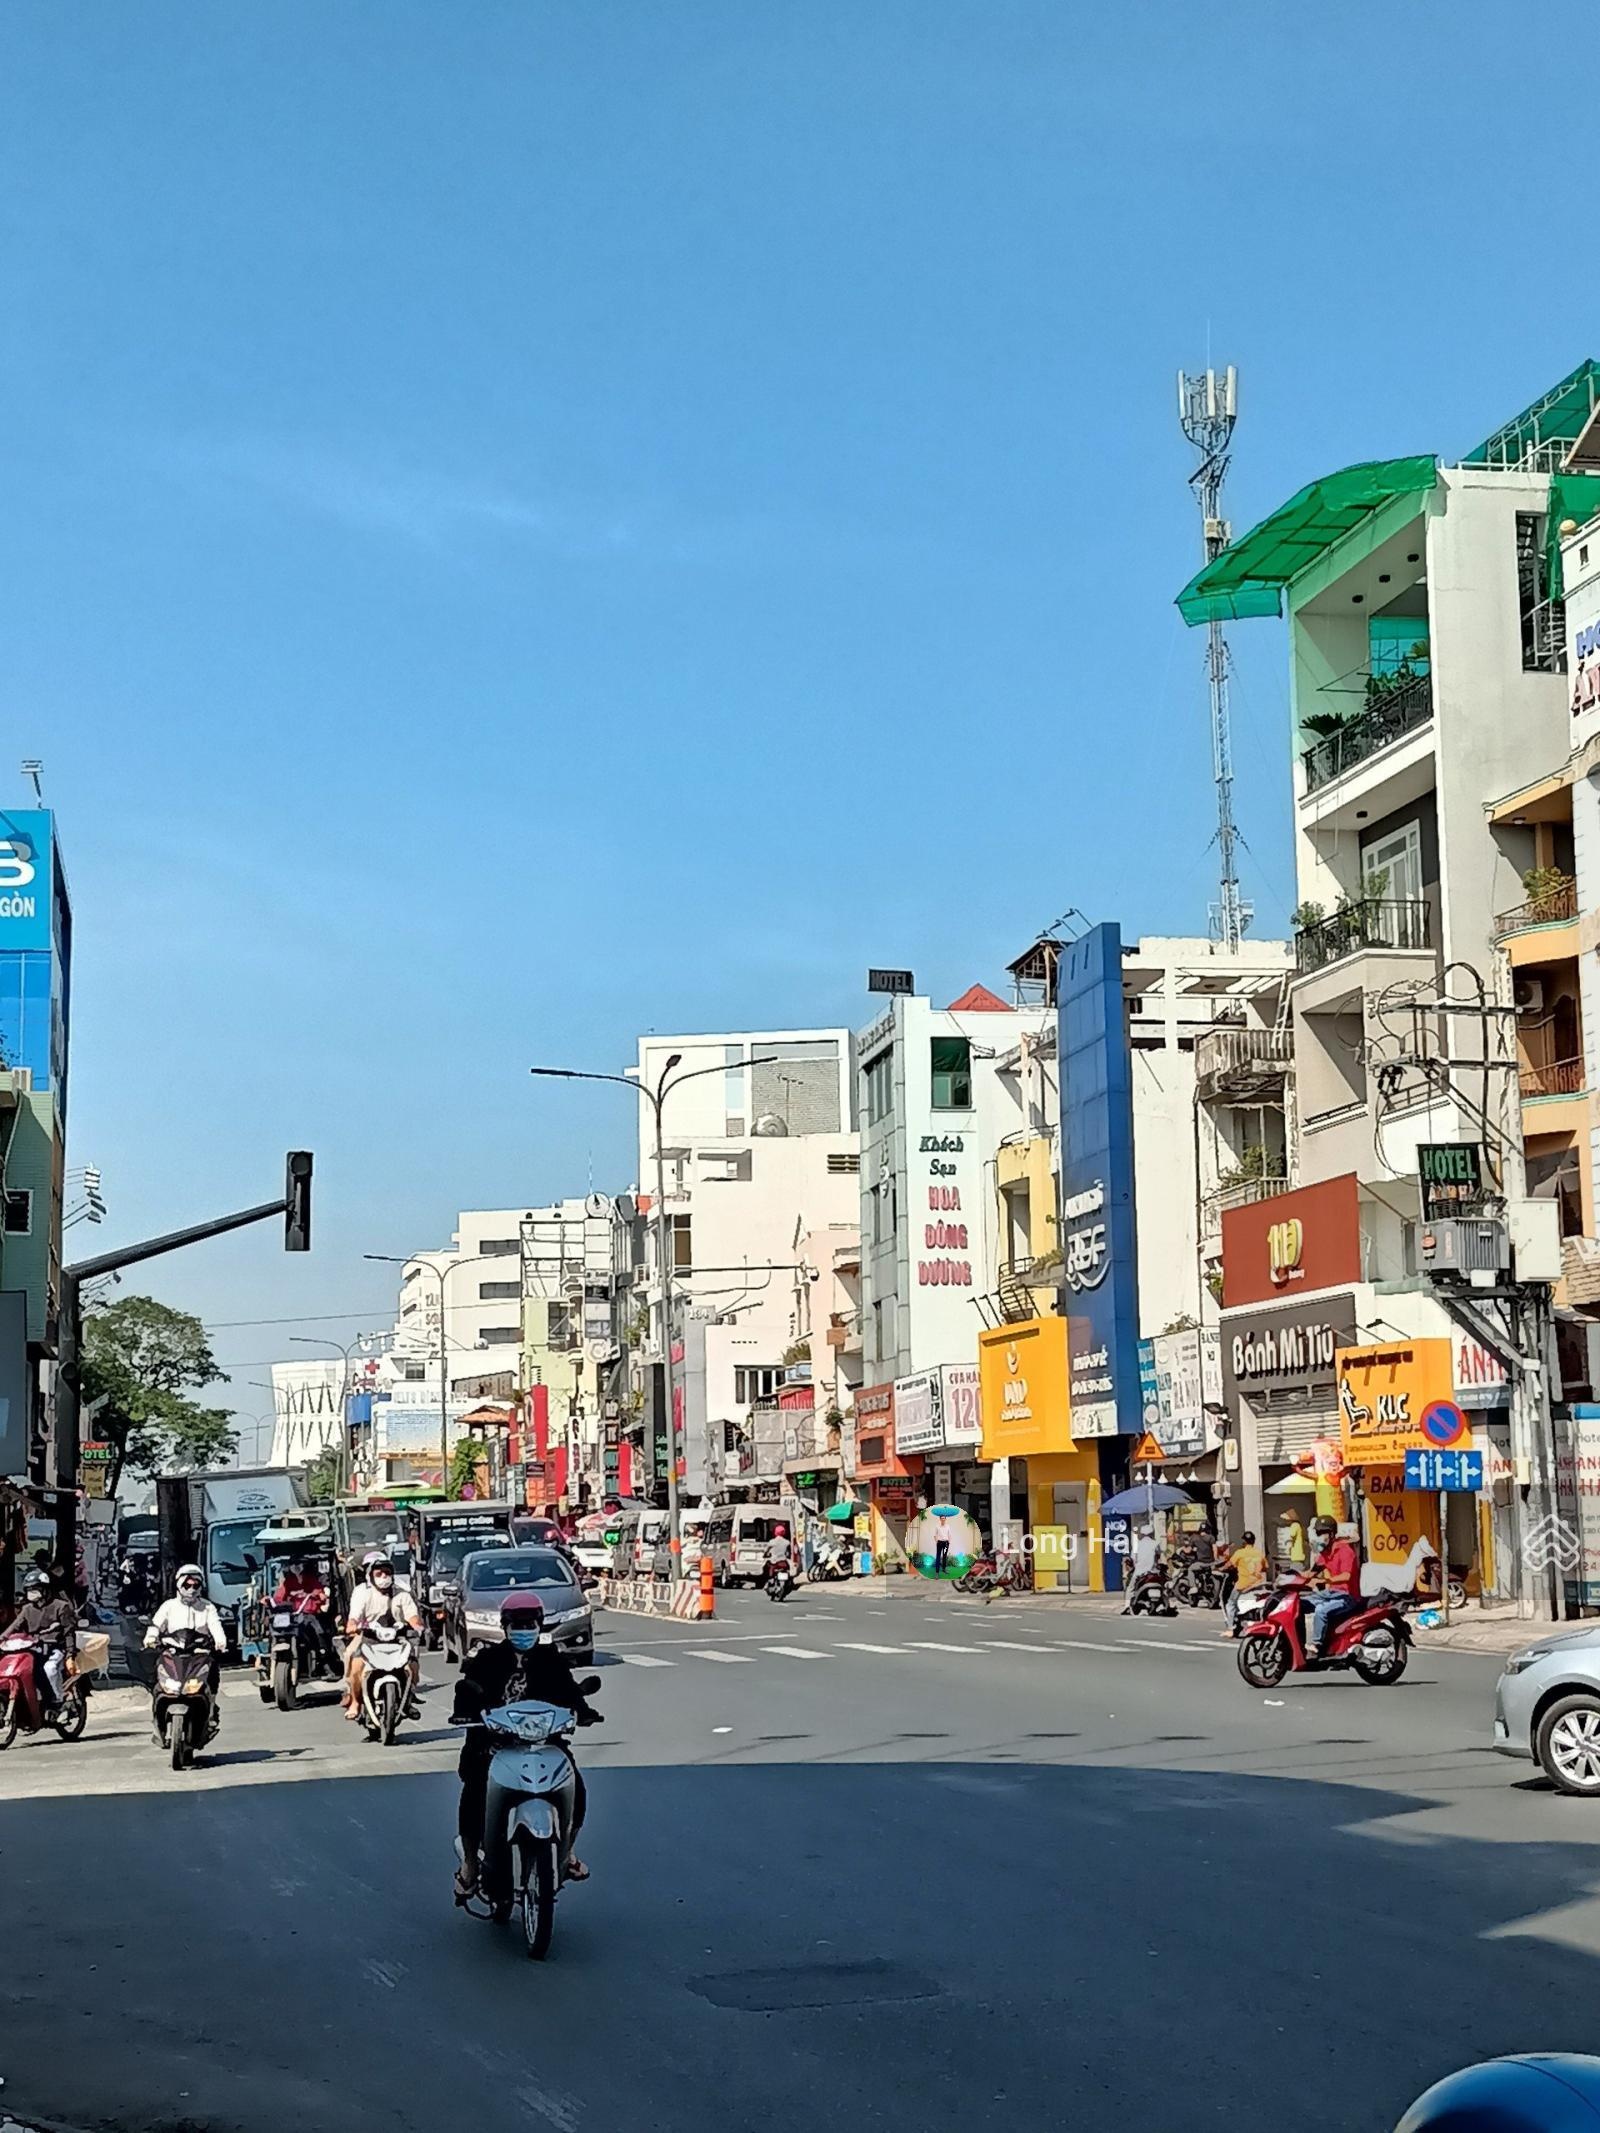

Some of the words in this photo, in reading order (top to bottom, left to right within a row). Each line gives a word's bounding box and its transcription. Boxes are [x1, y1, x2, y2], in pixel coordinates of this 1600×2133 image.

[871, 972, 910, 991] HOTEL
[919, 1135, 964, 1152] Khách
[930, 1159, 958, 1178] Sạn
[1423, 1149, 1477, 1180] HOTEL
[928, 1185, 961, 1211] HOA
[1233, 1332, 1277, 1375] Bánh
[1280, 1325, 1304, 1369] Mì
[1377, 1393, 1410, 1421] KLC
[81, 1449, 112, 1460] OTEL
[1370, 1471, 1406, 1494] BÁN
